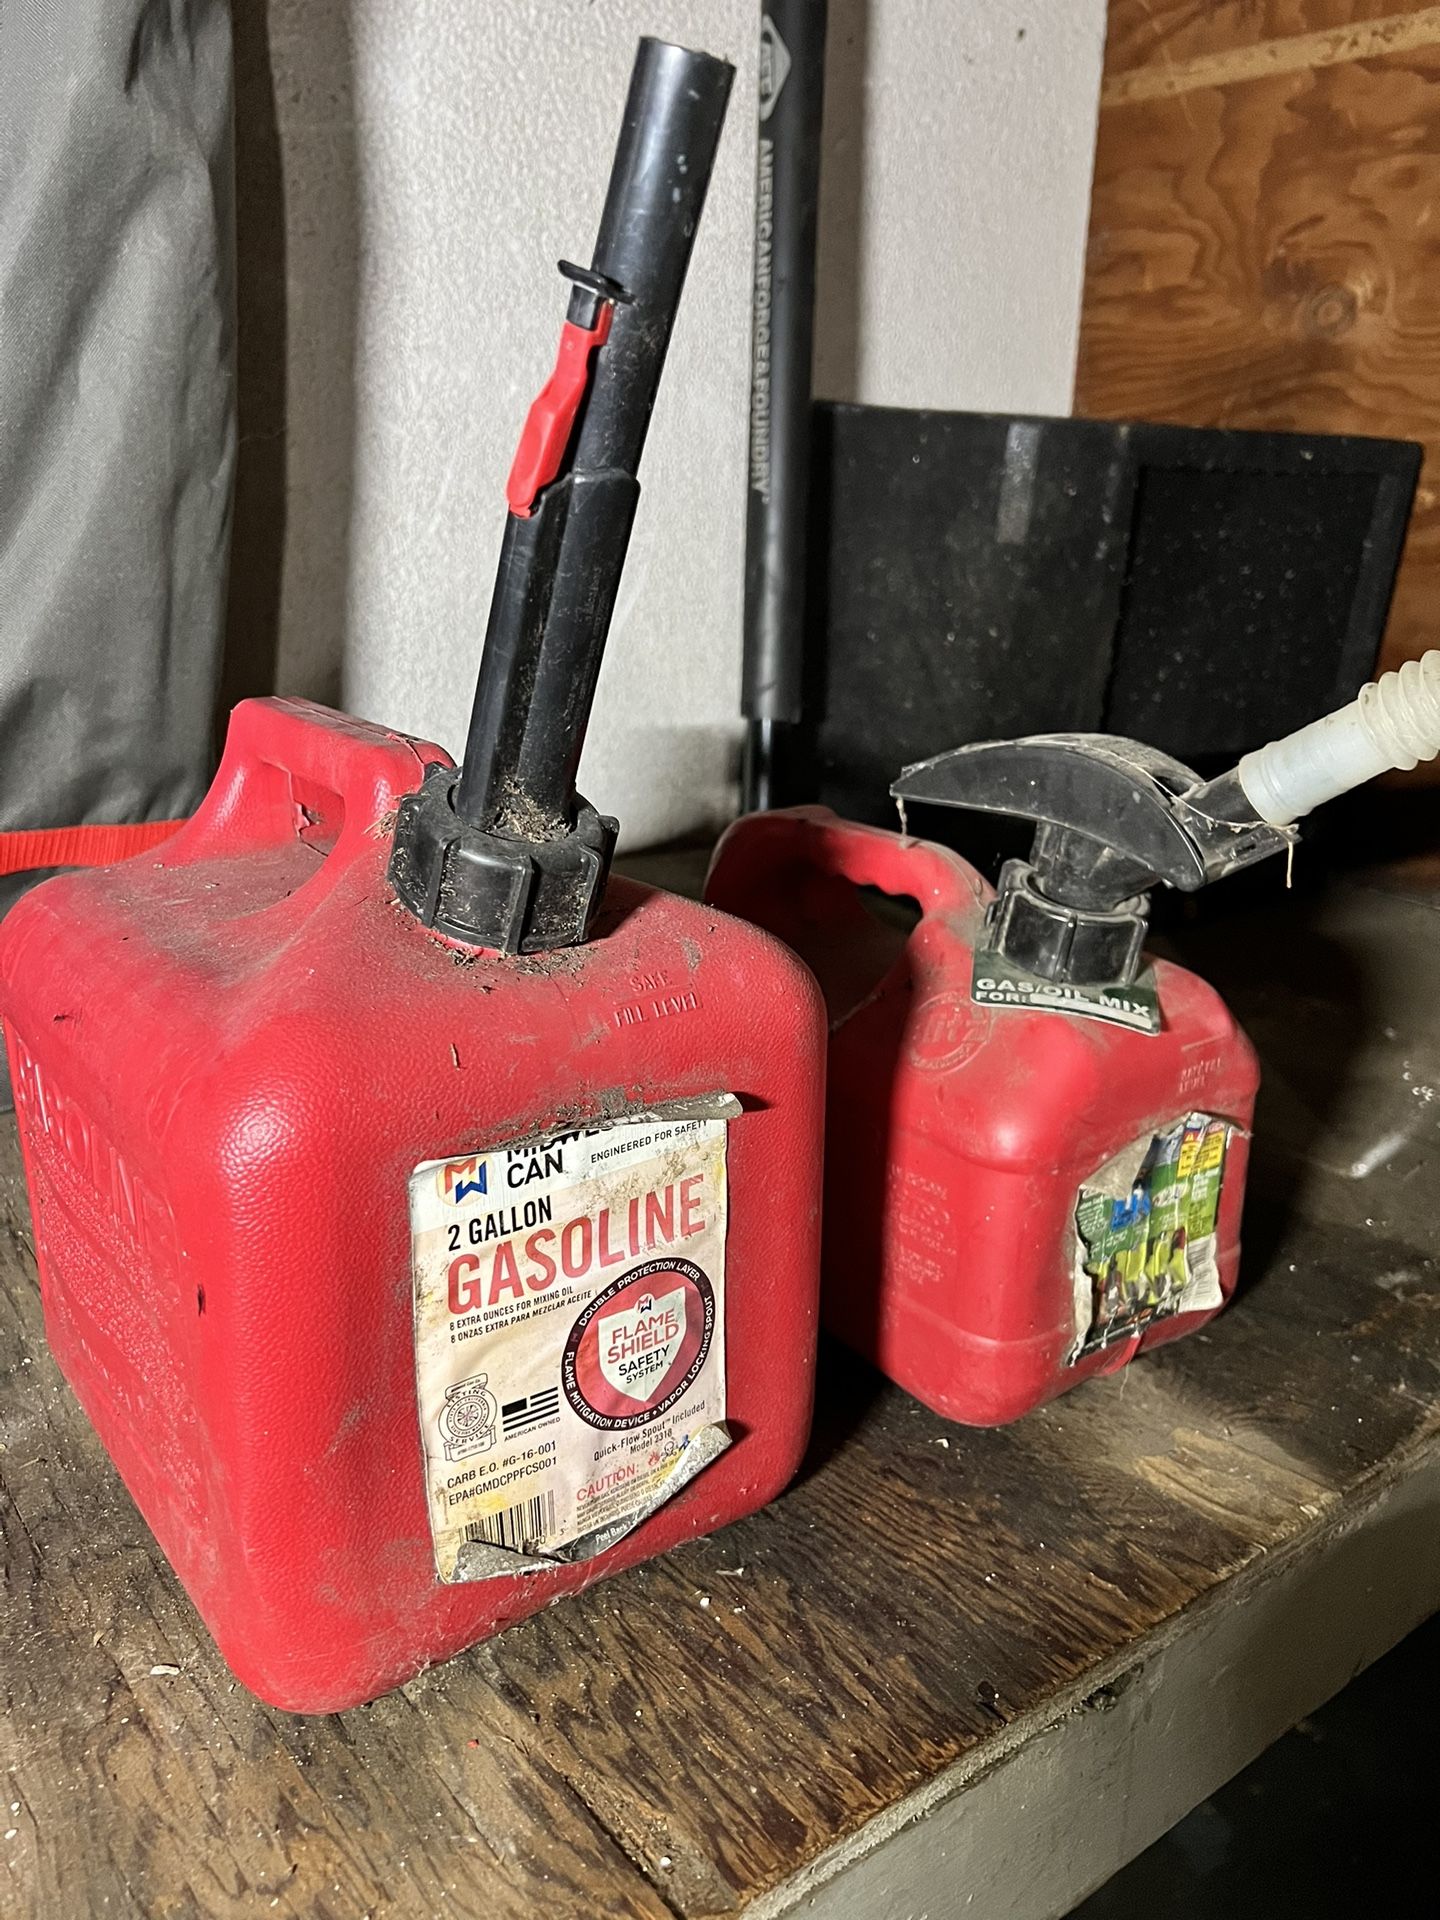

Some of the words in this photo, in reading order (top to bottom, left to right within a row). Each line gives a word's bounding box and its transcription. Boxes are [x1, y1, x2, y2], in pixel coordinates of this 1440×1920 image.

[975, 991, 1026, 1003] FOR:
[976, 978, 1089, 1003] GAS/OIL
[1099, 995, 1151, 1018] MIX
[591, 1136, 651, 1163] ENGINEERED
[654, 1130, 672, 1143] FOR
[675, 1120, 708, 1136] SAFETY
[507, 1149, 563, 1189] CAN
[448, 1224, 461, 1252] 2
[469, 1195, 552, 1245] GALLON
[448, 1174, 706, 1315] GASOLINE
[449, 1321, 455, 1331] 8
[457, 1314, 481, 1330] EXTRA
[483, 1305, 514, 1321] OUNCES
[516, 1298, 532, 1312] FOR
[534, 1290, 560, 1305] MIXING
[561, 1286, 573, 1297] OIL
[578, 1287, 616, 1327] DOUBLE
[617, 1261, 676, 1289] PROTECTION
[676, 1262, 701, 1282] LAYER
[703, 1295, 713, 1331] SPOUT
[450, 1334, 456, 1343] 8
[457, 1327, 483, 1342] ONZAS
[485, 1318, 509, 1334] EXTRA
[511, 1311, 531, 1326] PARA
[532, 1300, 565, 1317] MEZCLAR
[567, 1290, 592, 1305] ACEITE
[612, 1308, 676, 1345] FLAME
[607, 1323, 679, 1364] SHIELD
[618, 1344, 671, 1376] SAFETY
[687, 1332, 711, 1381] LOCKING
[563, 1351, 576, 1390] FLAME
[626, 1360, 664, 1384] SYSTEM
[569, 1390, 613, 1428] MITIGATION
[657, 1380, 689, 1413] VAPOR
[504, 1425, 536, 1442] AMERICAN
[537, 1416, 561, 1429] OWNED
[593, 1433, 640, 1461] Quick-Flow
[672, 1400, 706, 1425] Included
[614, 1413, 650, 1428] DEVICE
[447, 1469, 477, 1489] CARB
[479, 1462, 500, 1477] E.O.
[502, 1440, 556, 1467] #G-16-001
[630, 1441, 653, 1455] Model
[576, 1463, 640, 1502] CAUTION:
